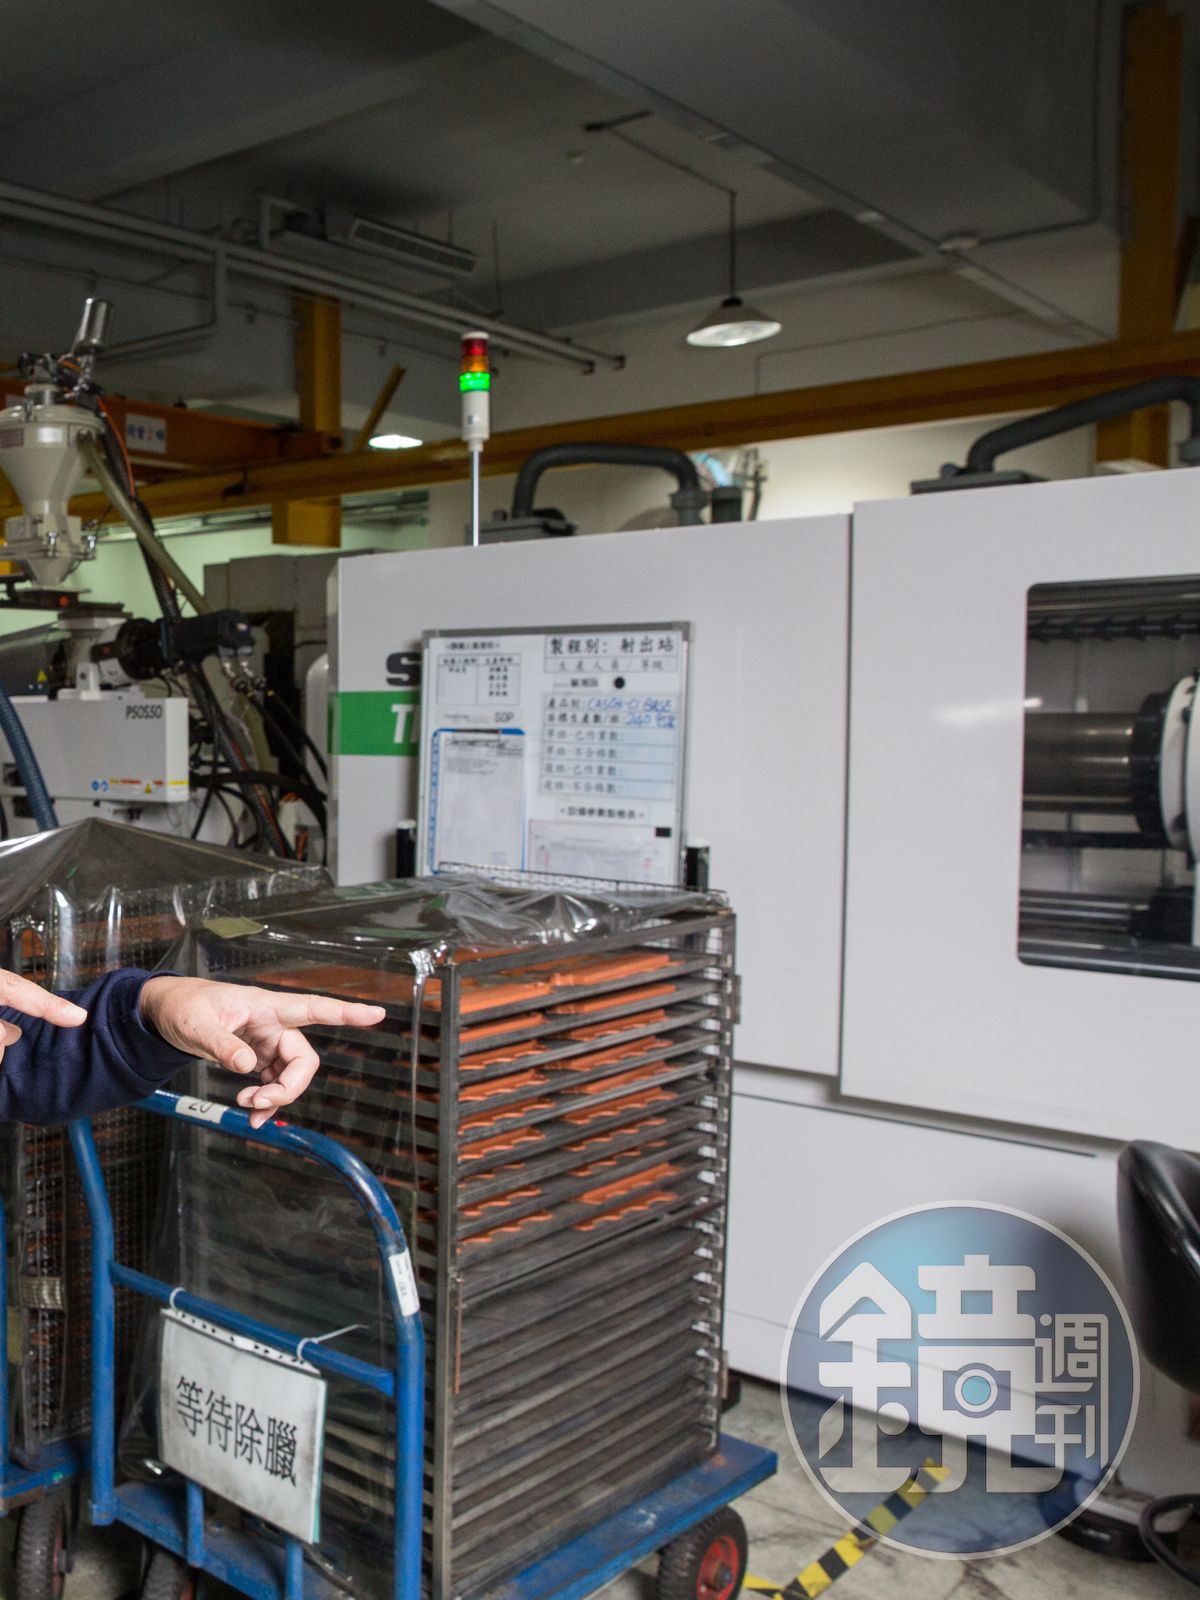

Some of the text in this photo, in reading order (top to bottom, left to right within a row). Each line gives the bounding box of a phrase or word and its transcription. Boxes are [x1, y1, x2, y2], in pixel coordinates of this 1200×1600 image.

[620, 635, 674, 654] 射出站
[493, 711, 515, 724] SOP
[176, 1375, 298, 1488] 等待除臘
